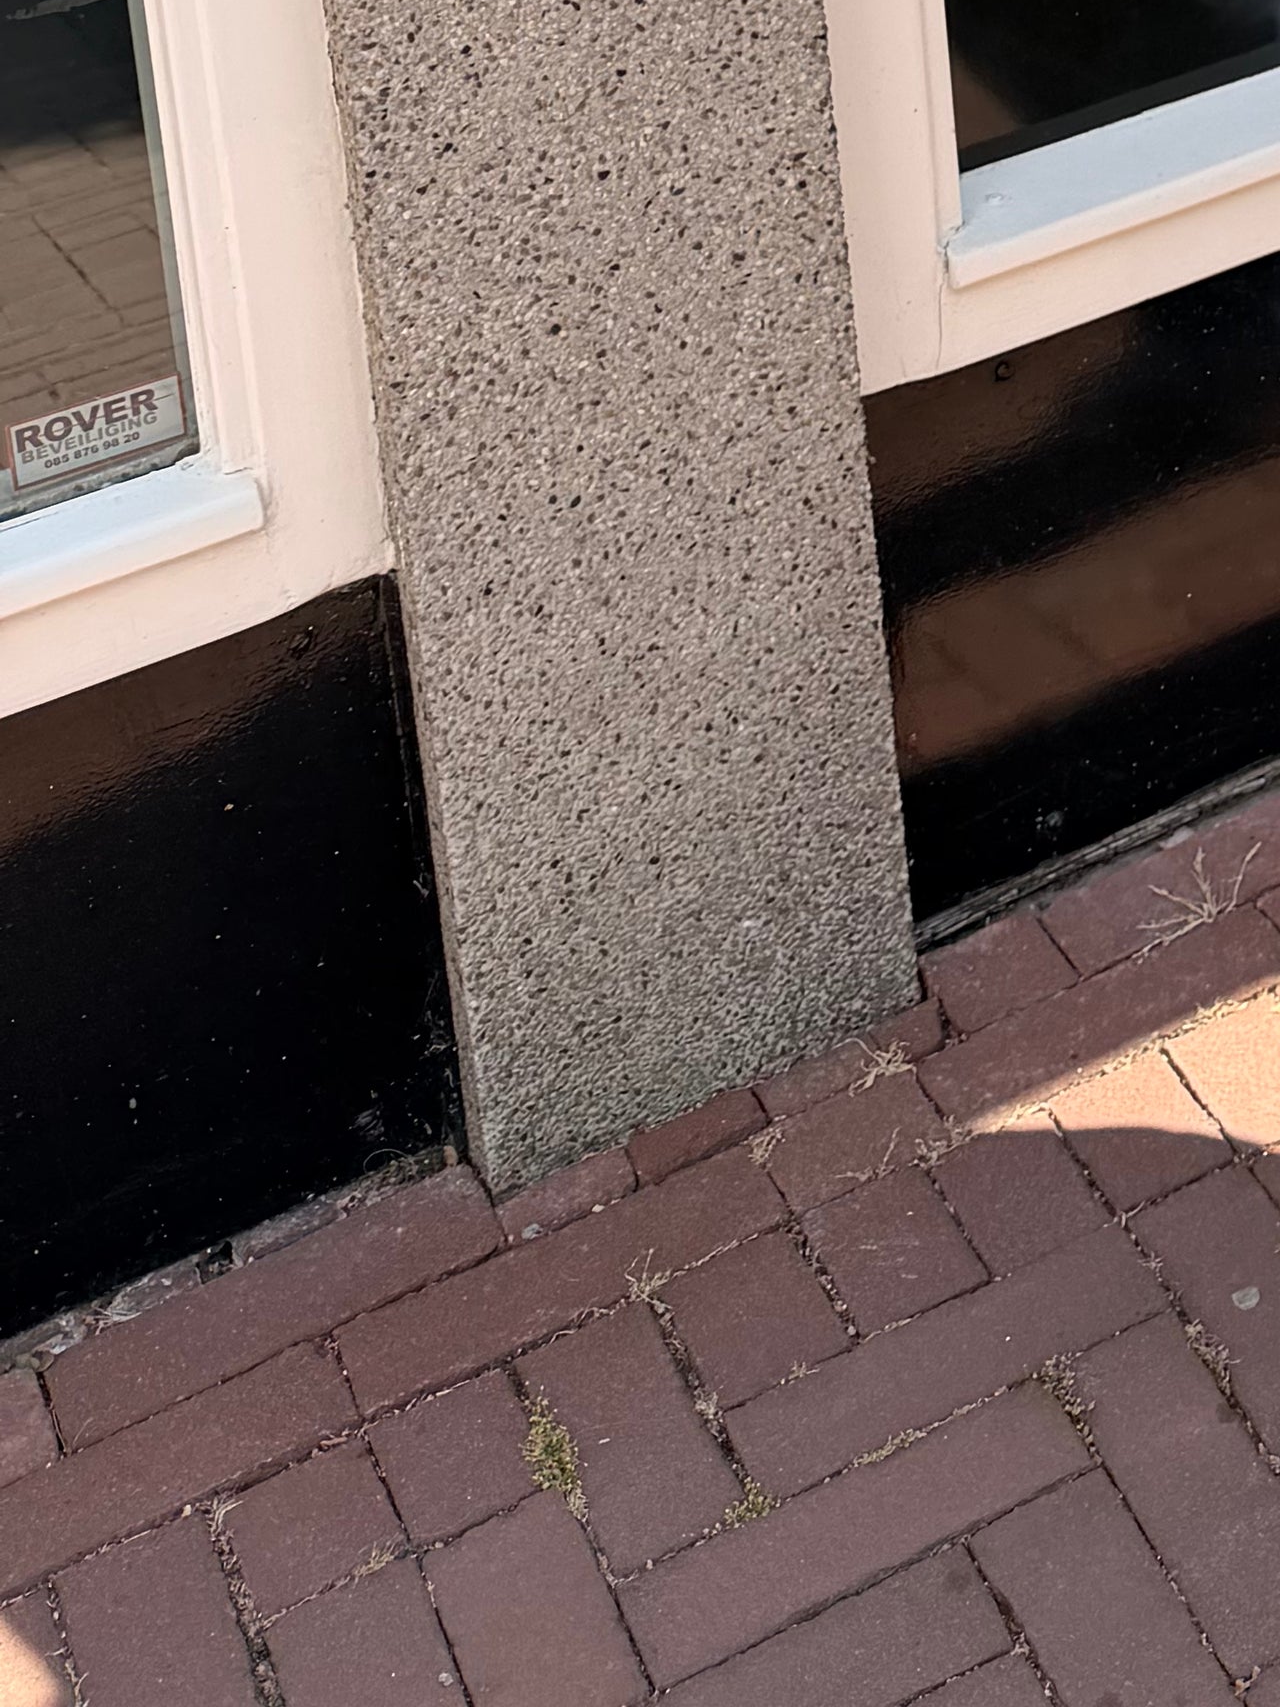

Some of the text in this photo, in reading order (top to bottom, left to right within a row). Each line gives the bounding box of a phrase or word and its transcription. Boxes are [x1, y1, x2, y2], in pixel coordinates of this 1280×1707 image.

[15, 388, 158, 453] ROVER
[44, 454, 70, 469] 085
[104, 439, 120, 451] 98
[124, 431, 140, 444] 20
